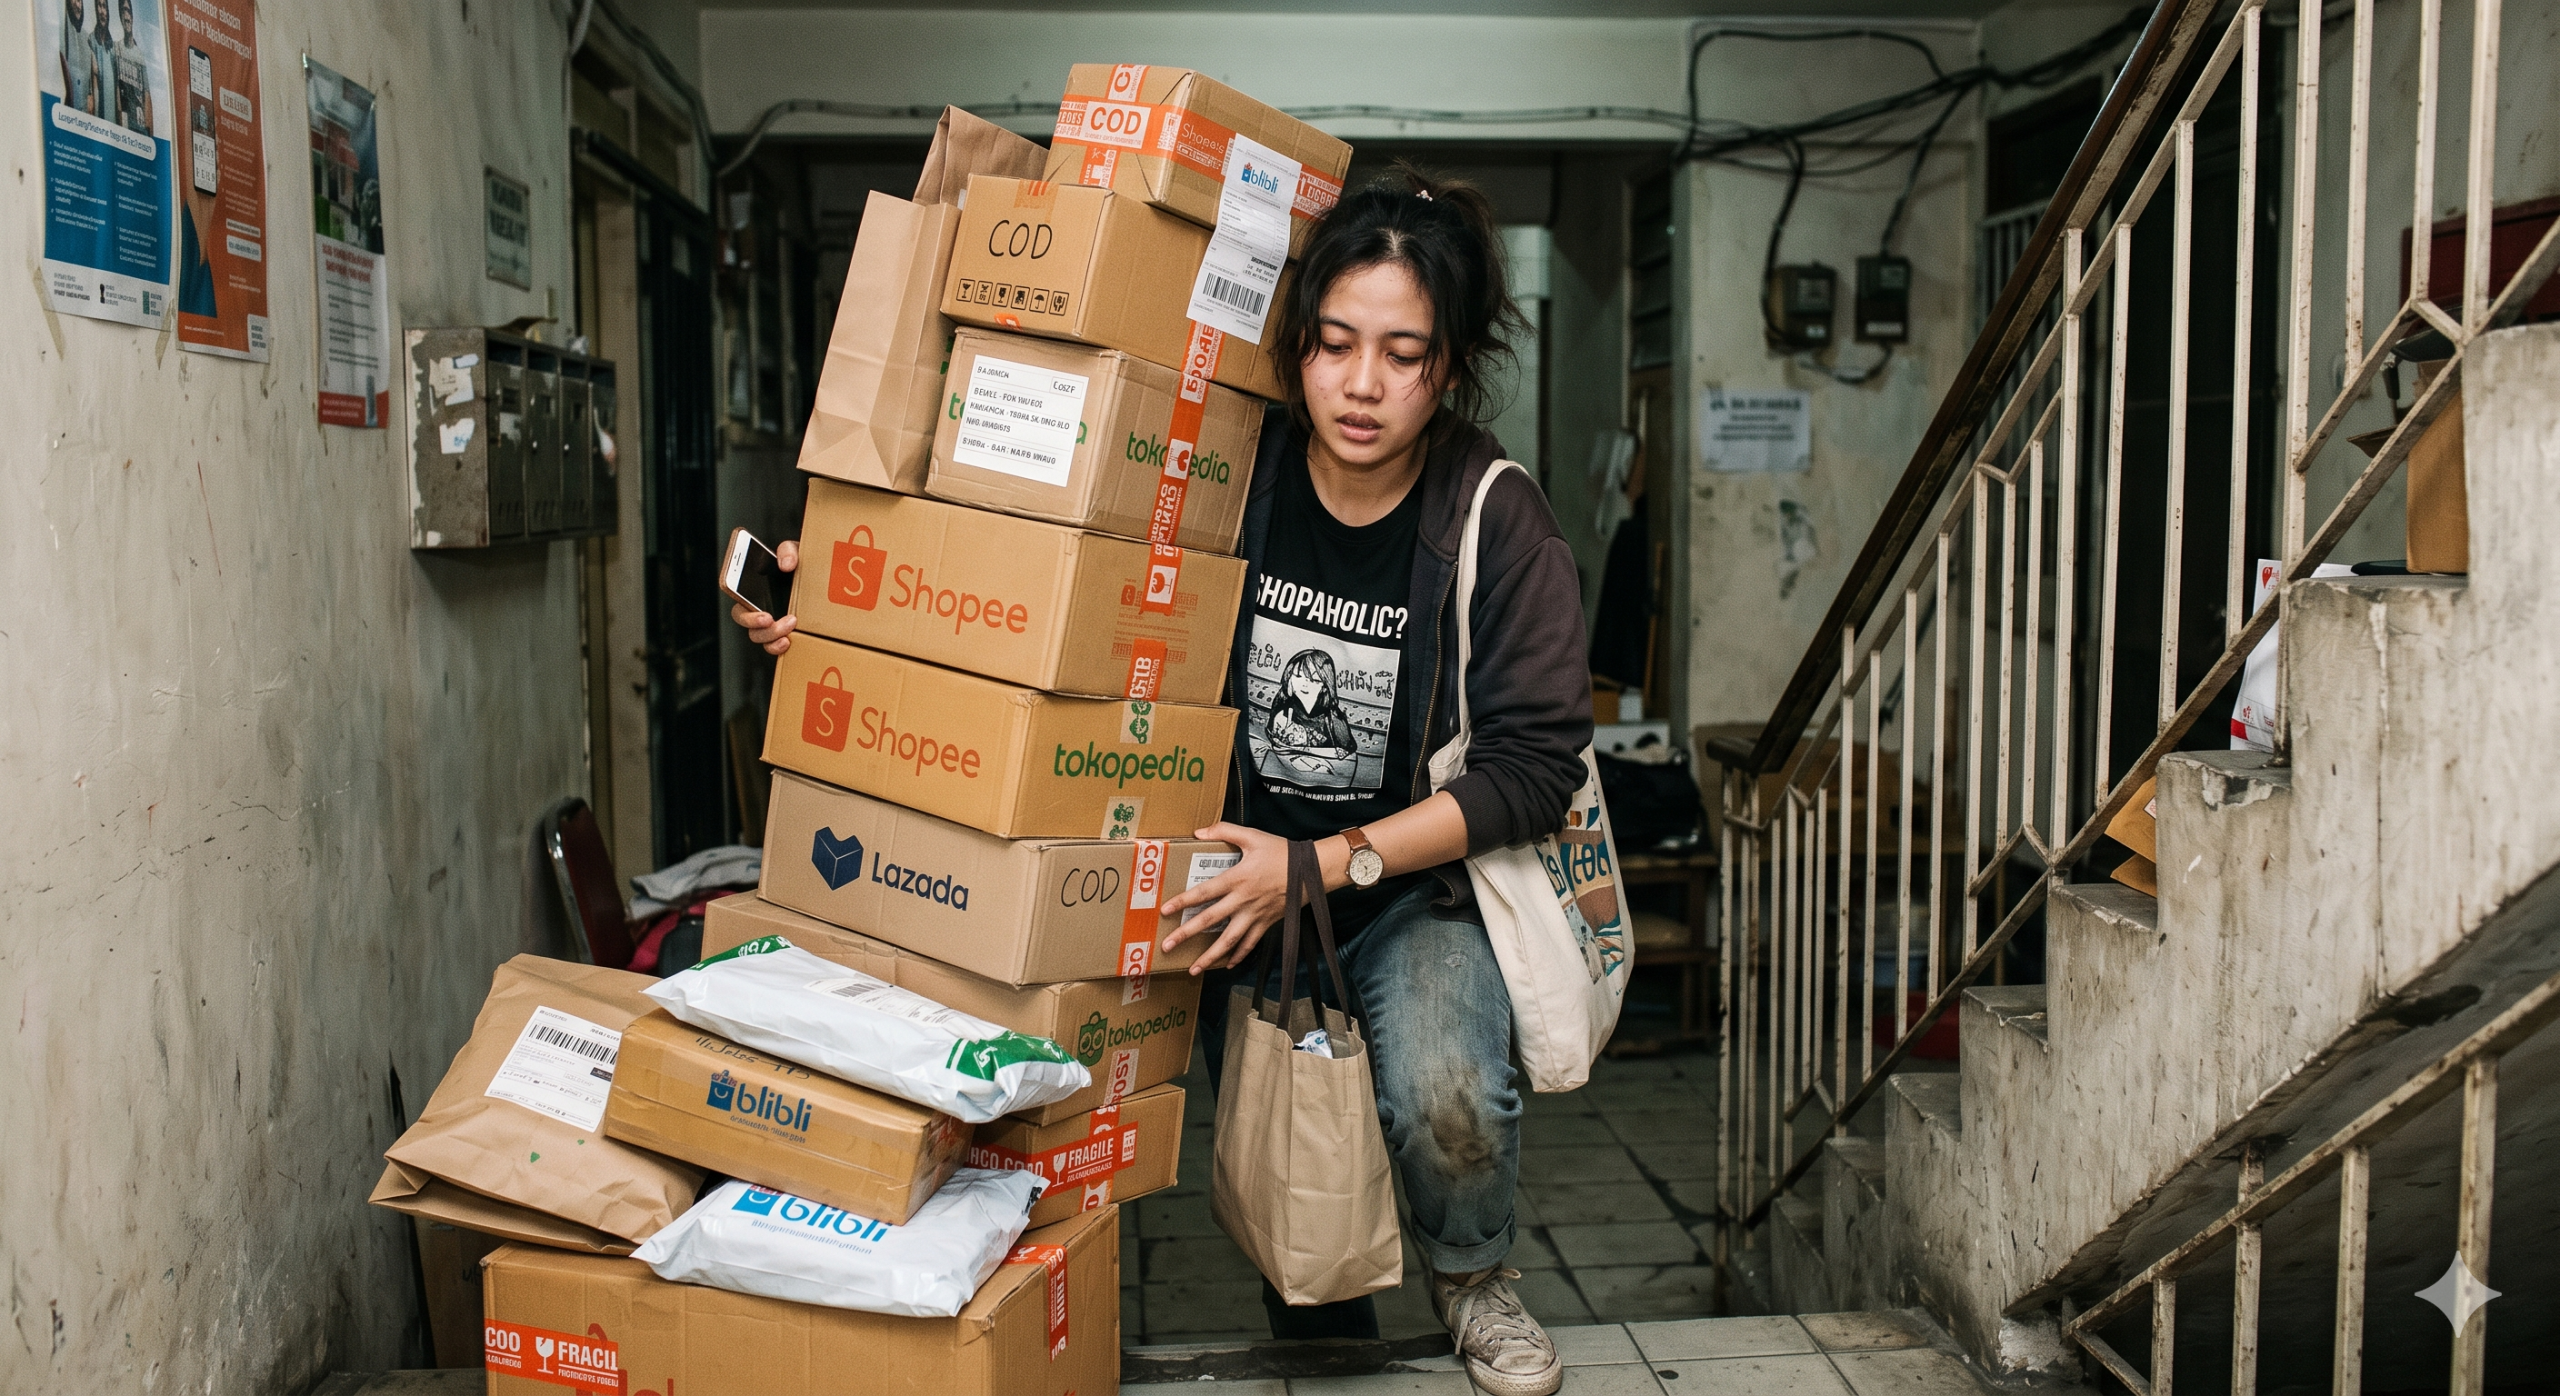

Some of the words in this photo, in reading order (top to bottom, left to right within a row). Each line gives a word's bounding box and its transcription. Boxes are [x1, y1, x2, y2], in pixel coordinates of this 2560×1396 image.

[1090, 107, 1142, 135] COD
[1251, 170, 1279, 194] blibli
[988, 219, 1053, 260] COD
[1126, 431, 1230, 485] tokedia
[889, 563, 1029, 636] Shopee
[856, 705, 981, 780] Shopee
[1053, 741, 1205, 789] tokopedia
[871, 851, 970, 912] Lazada
[1061, 866, 1120, 907] COD
[1138, 844, 1159, 893] COD
[1107, 1005, 1187, 1048] tokopedia
[736, 1083, 812, 1132] blibli
[1068, 1137, 1114, 1169] FRAGILE
[780, 1197, 894, 1242] blibli
